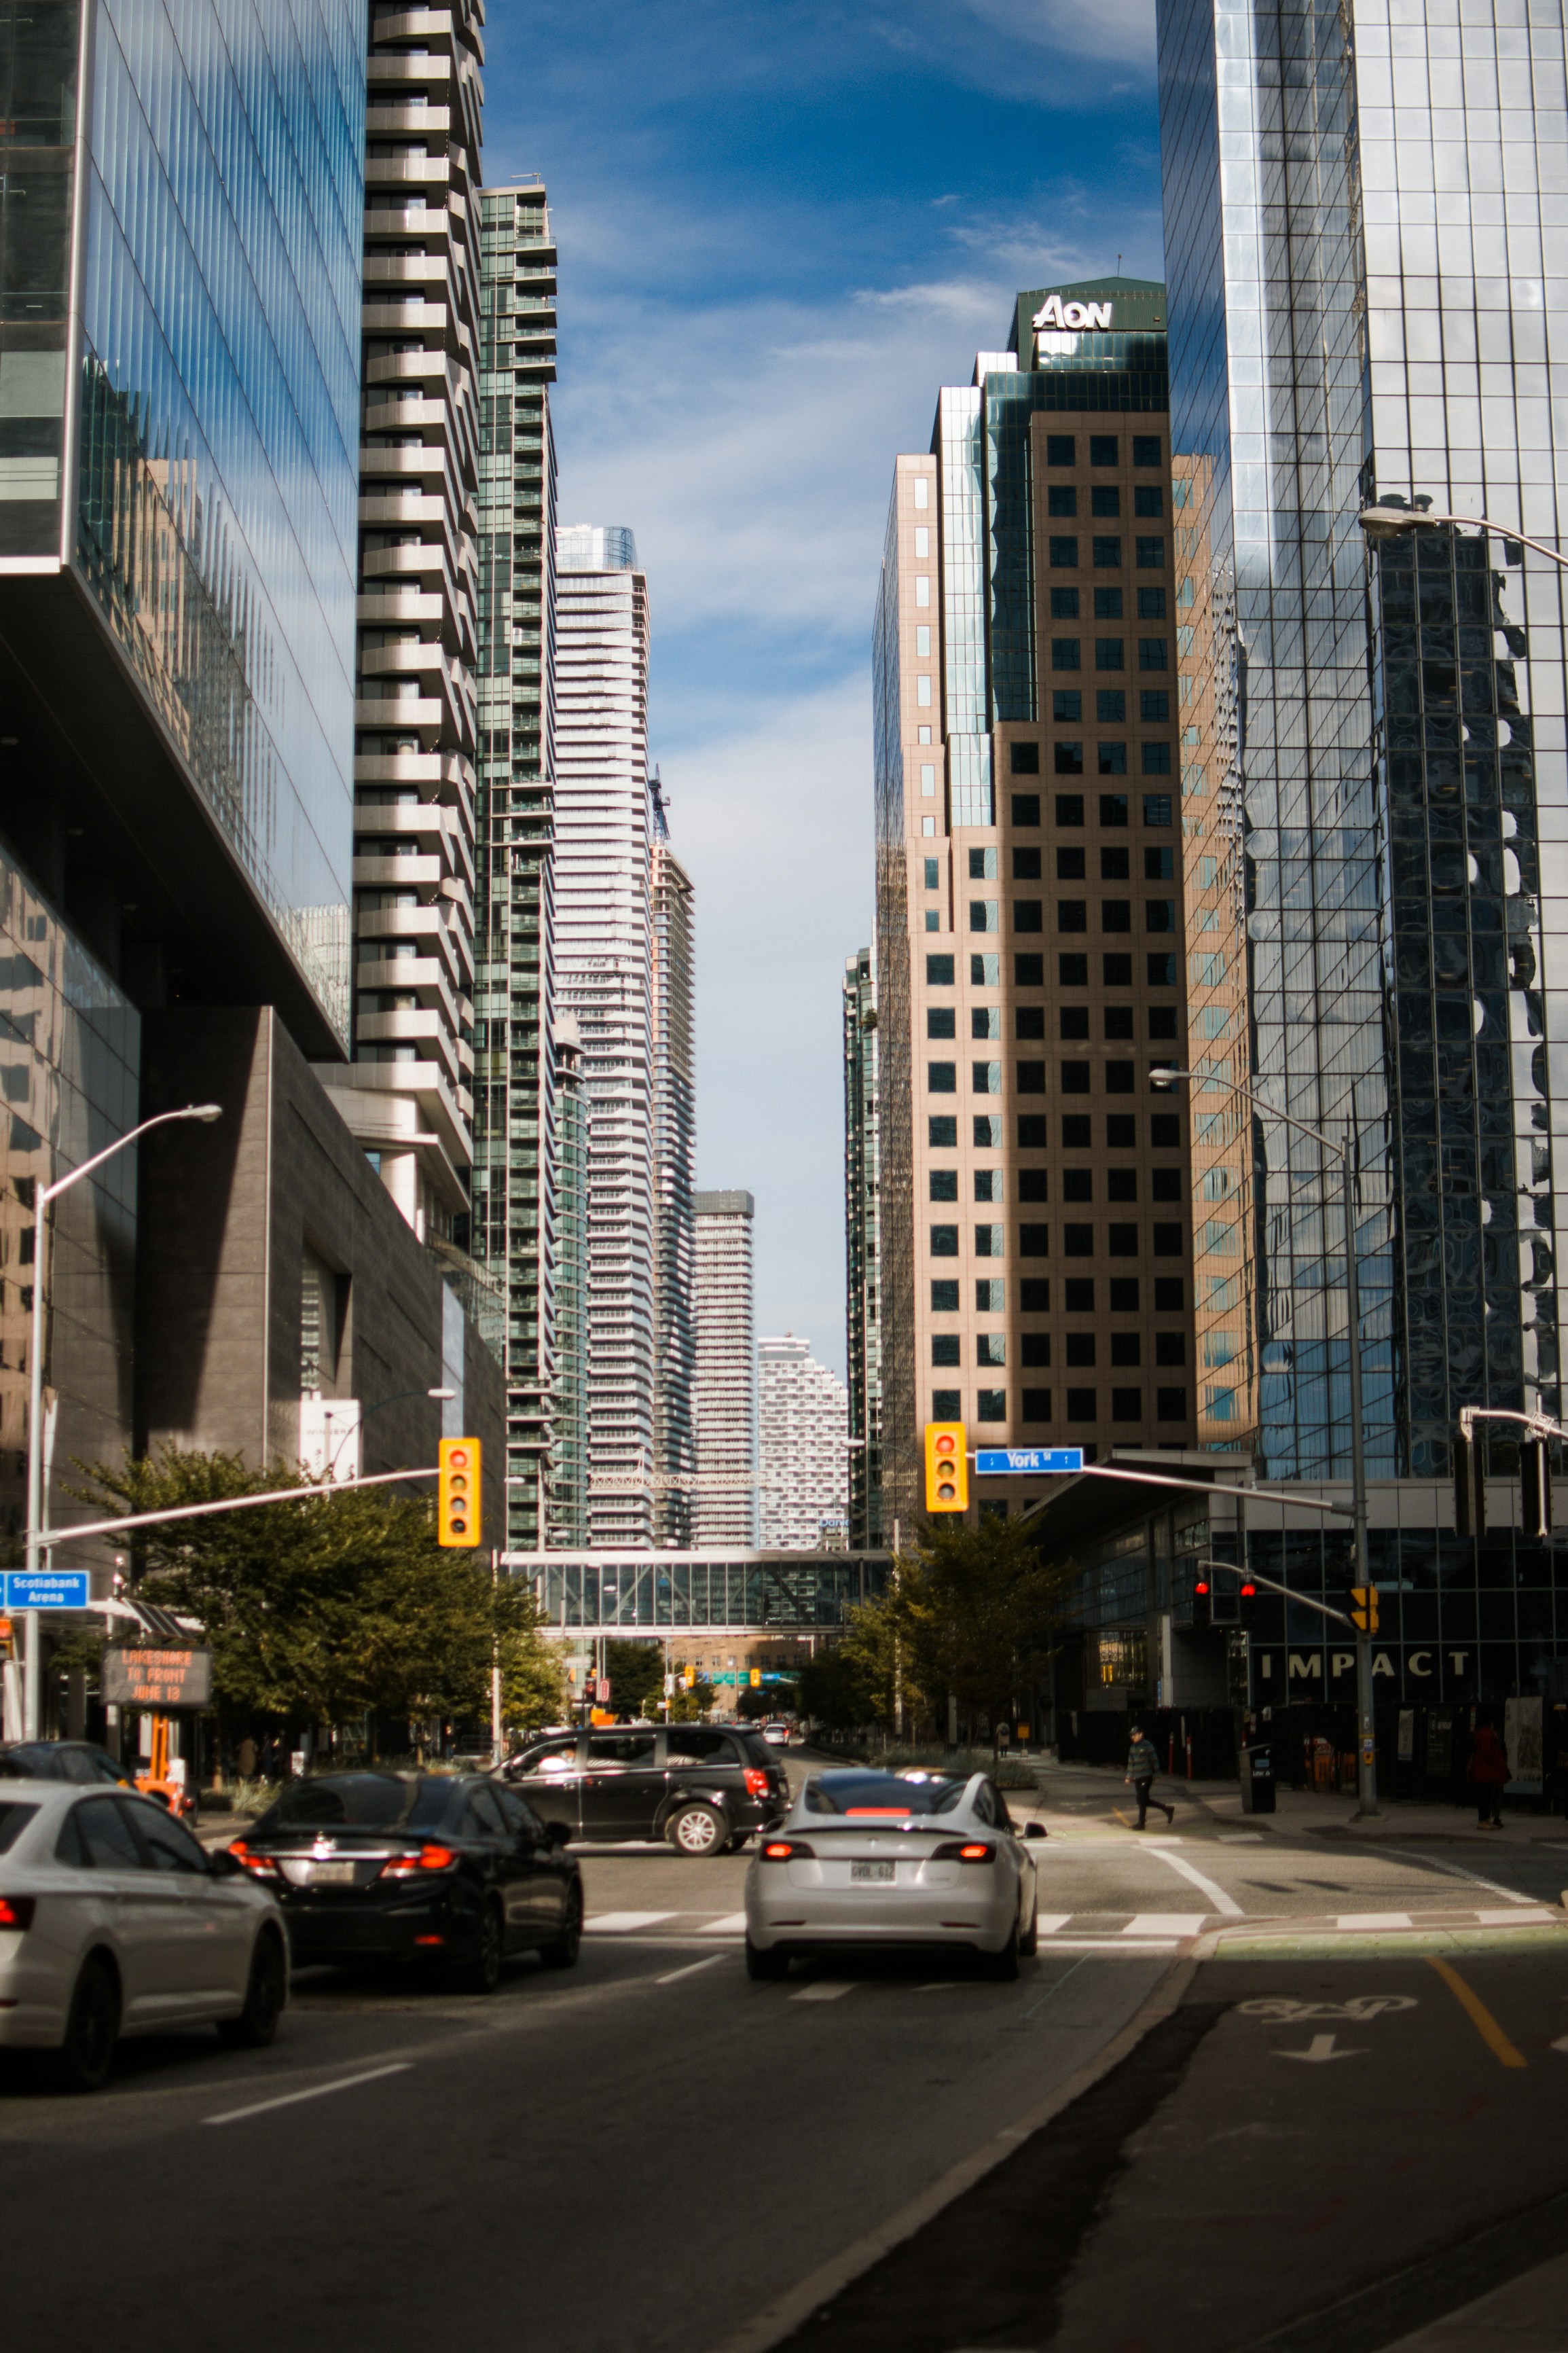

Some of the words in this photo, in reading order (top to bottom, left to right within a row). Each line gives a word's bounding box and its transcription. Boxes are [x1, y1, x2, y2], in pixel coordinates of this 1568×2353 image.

[1006, 1452, 1039, 1468] York
[1043, 1452, 1051, 1460] St
[13, 1577, 80, 1589] Scotiabank
[28, 1591, 65, 1602] Arena
[1262, 1651, 1470, 1678] IMPACT
